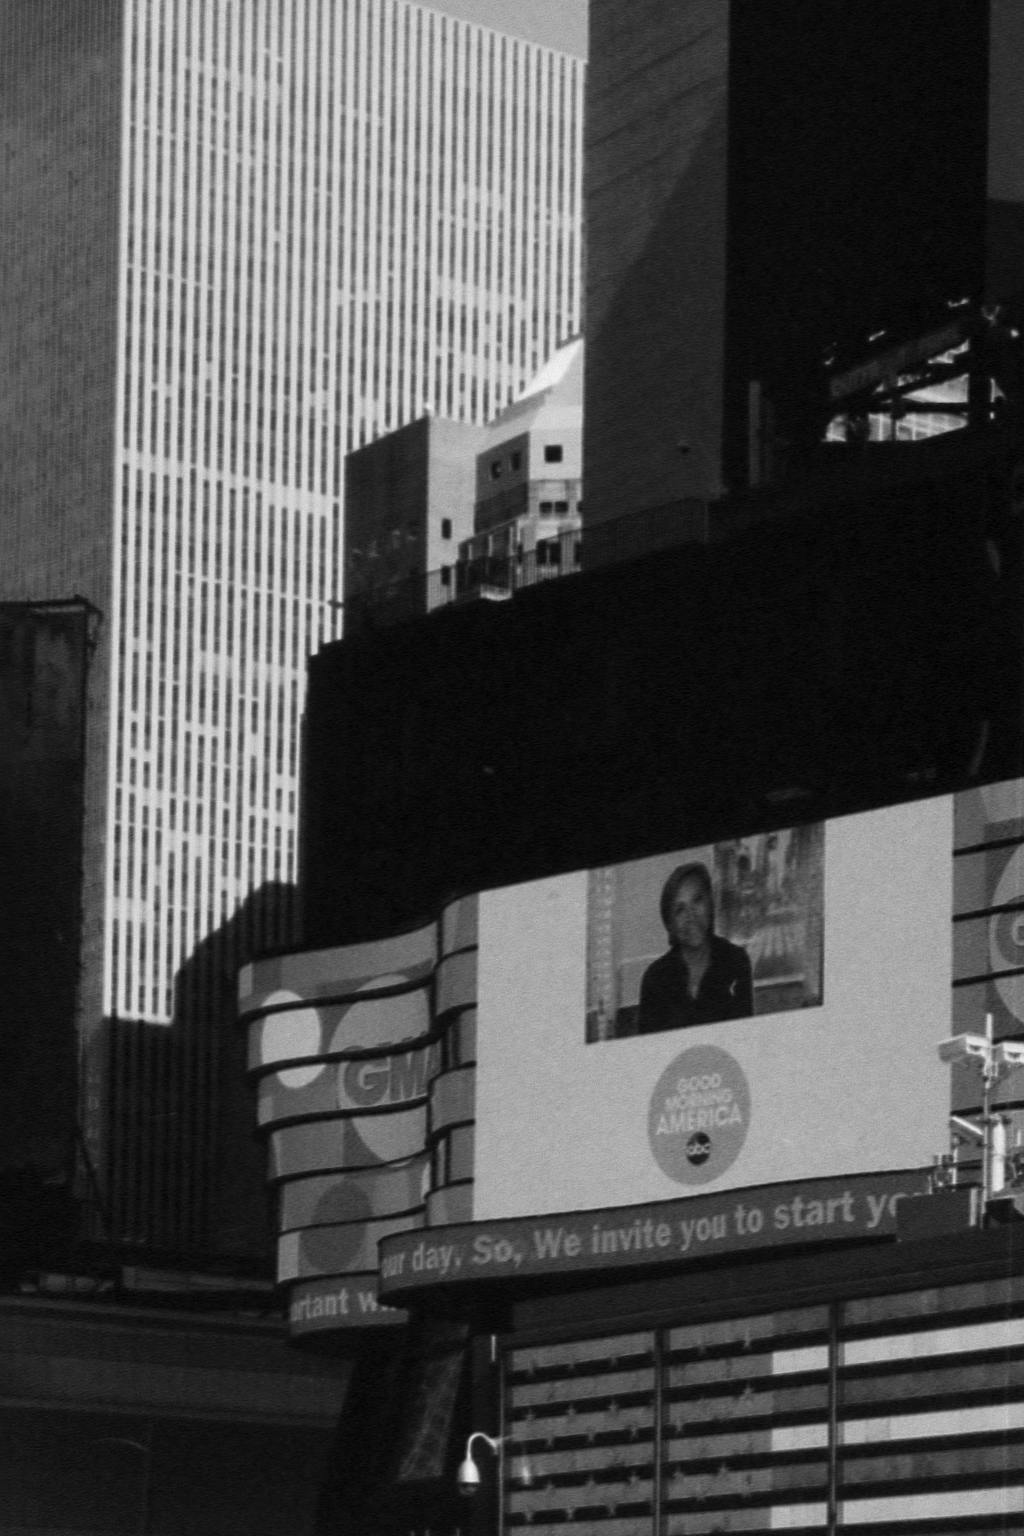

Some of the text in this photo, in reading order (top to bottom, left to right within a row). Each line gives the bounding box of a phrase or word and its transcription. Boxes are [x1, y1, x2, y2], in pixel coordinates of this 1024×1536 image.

[676, 1072, 723, 1095] GOOD
[664, 1086, 734, 1113] MORNING
[655, 1102, 743, 1136] AMERICA
[472, 1233, 524, 1269] So,
[534, 1226, 583, 1261] We
[592, 1217, 672, 1256] invite
[681, 1213, 728, 1251] you
[734, 1203, 764, 1236] to
[775, 1190, 856, 1231] start
